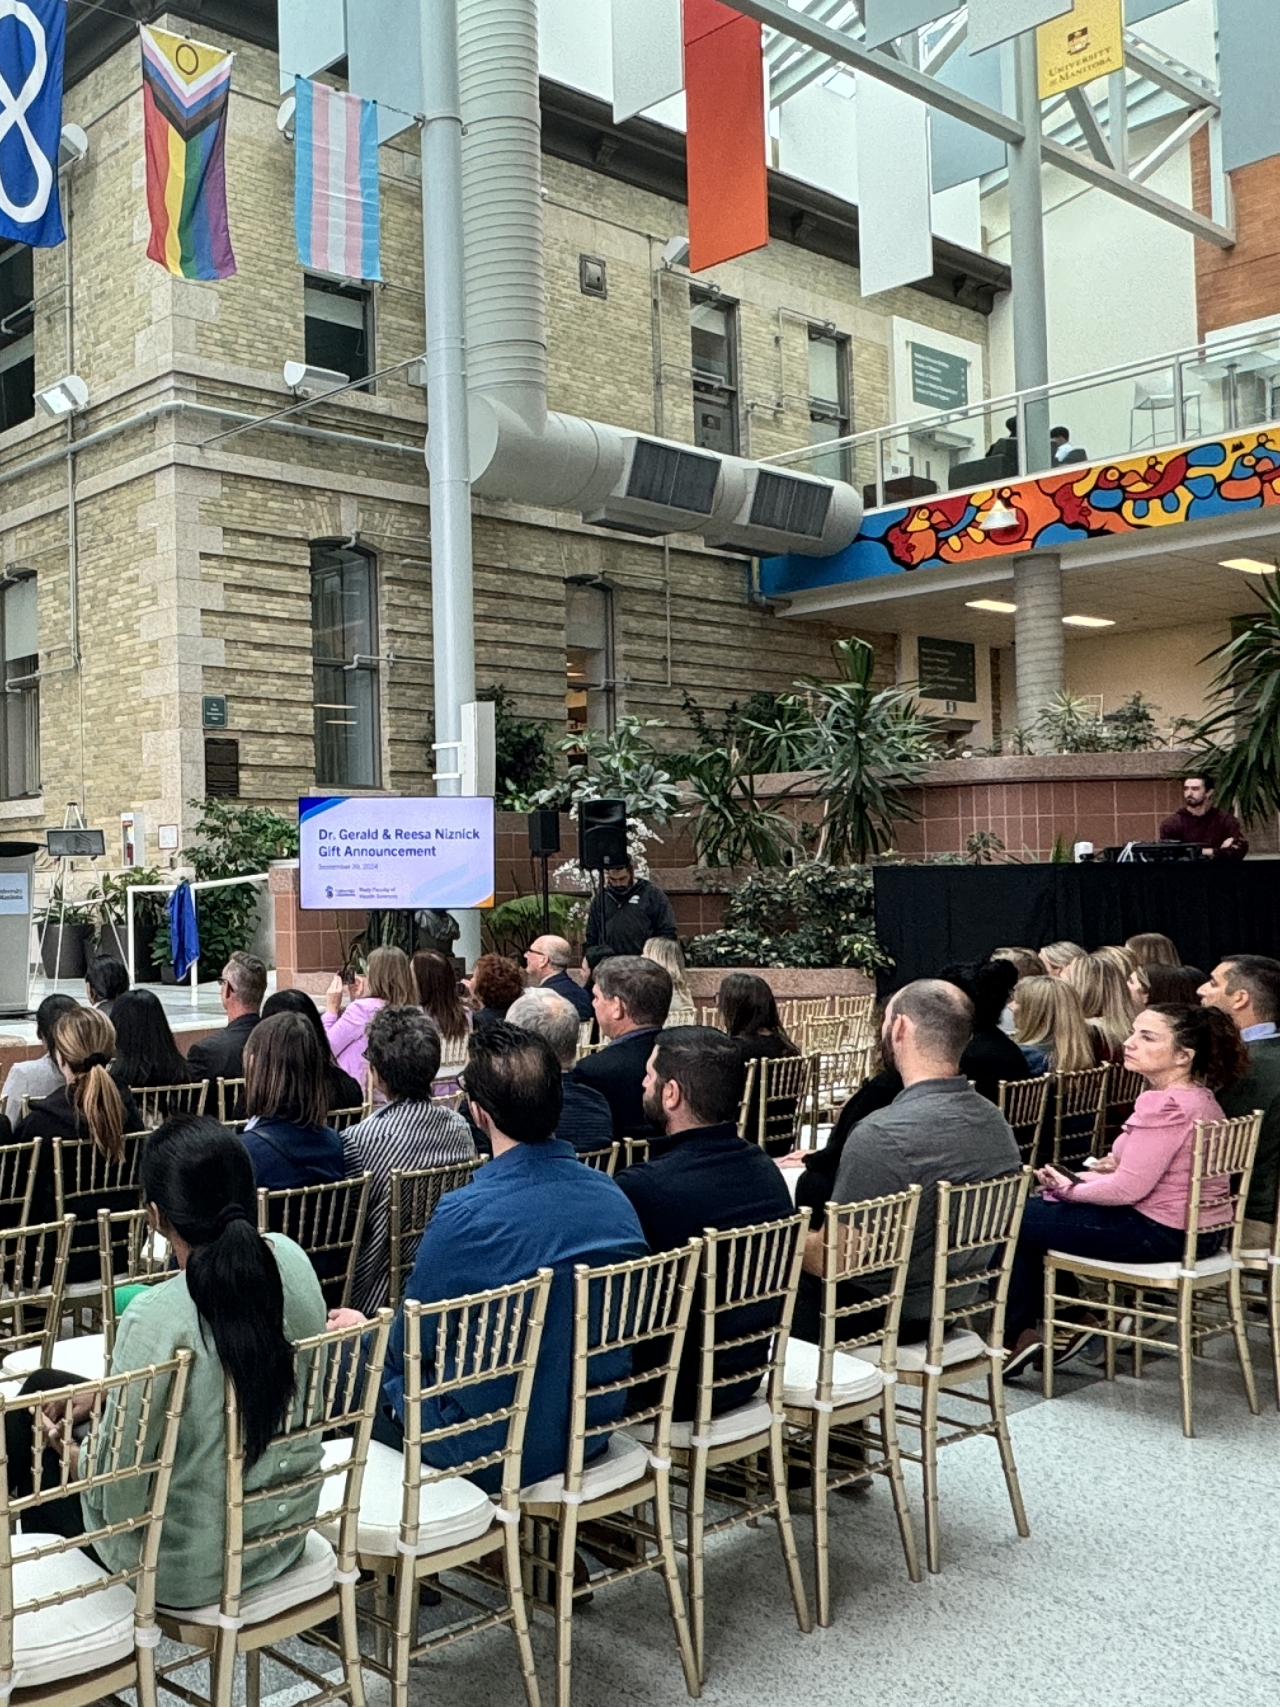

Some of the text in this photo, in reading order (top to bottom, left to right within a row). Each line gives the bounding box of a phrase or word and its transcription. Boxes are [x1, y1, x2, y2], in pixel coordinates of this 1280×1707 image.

[1048, 46, 1112, 77] UNIVERSITY
[318, 828, 480, 840] Dr. Gerald & Reesa Niznick
[318, 846, 436, 857] Gift Announcement
